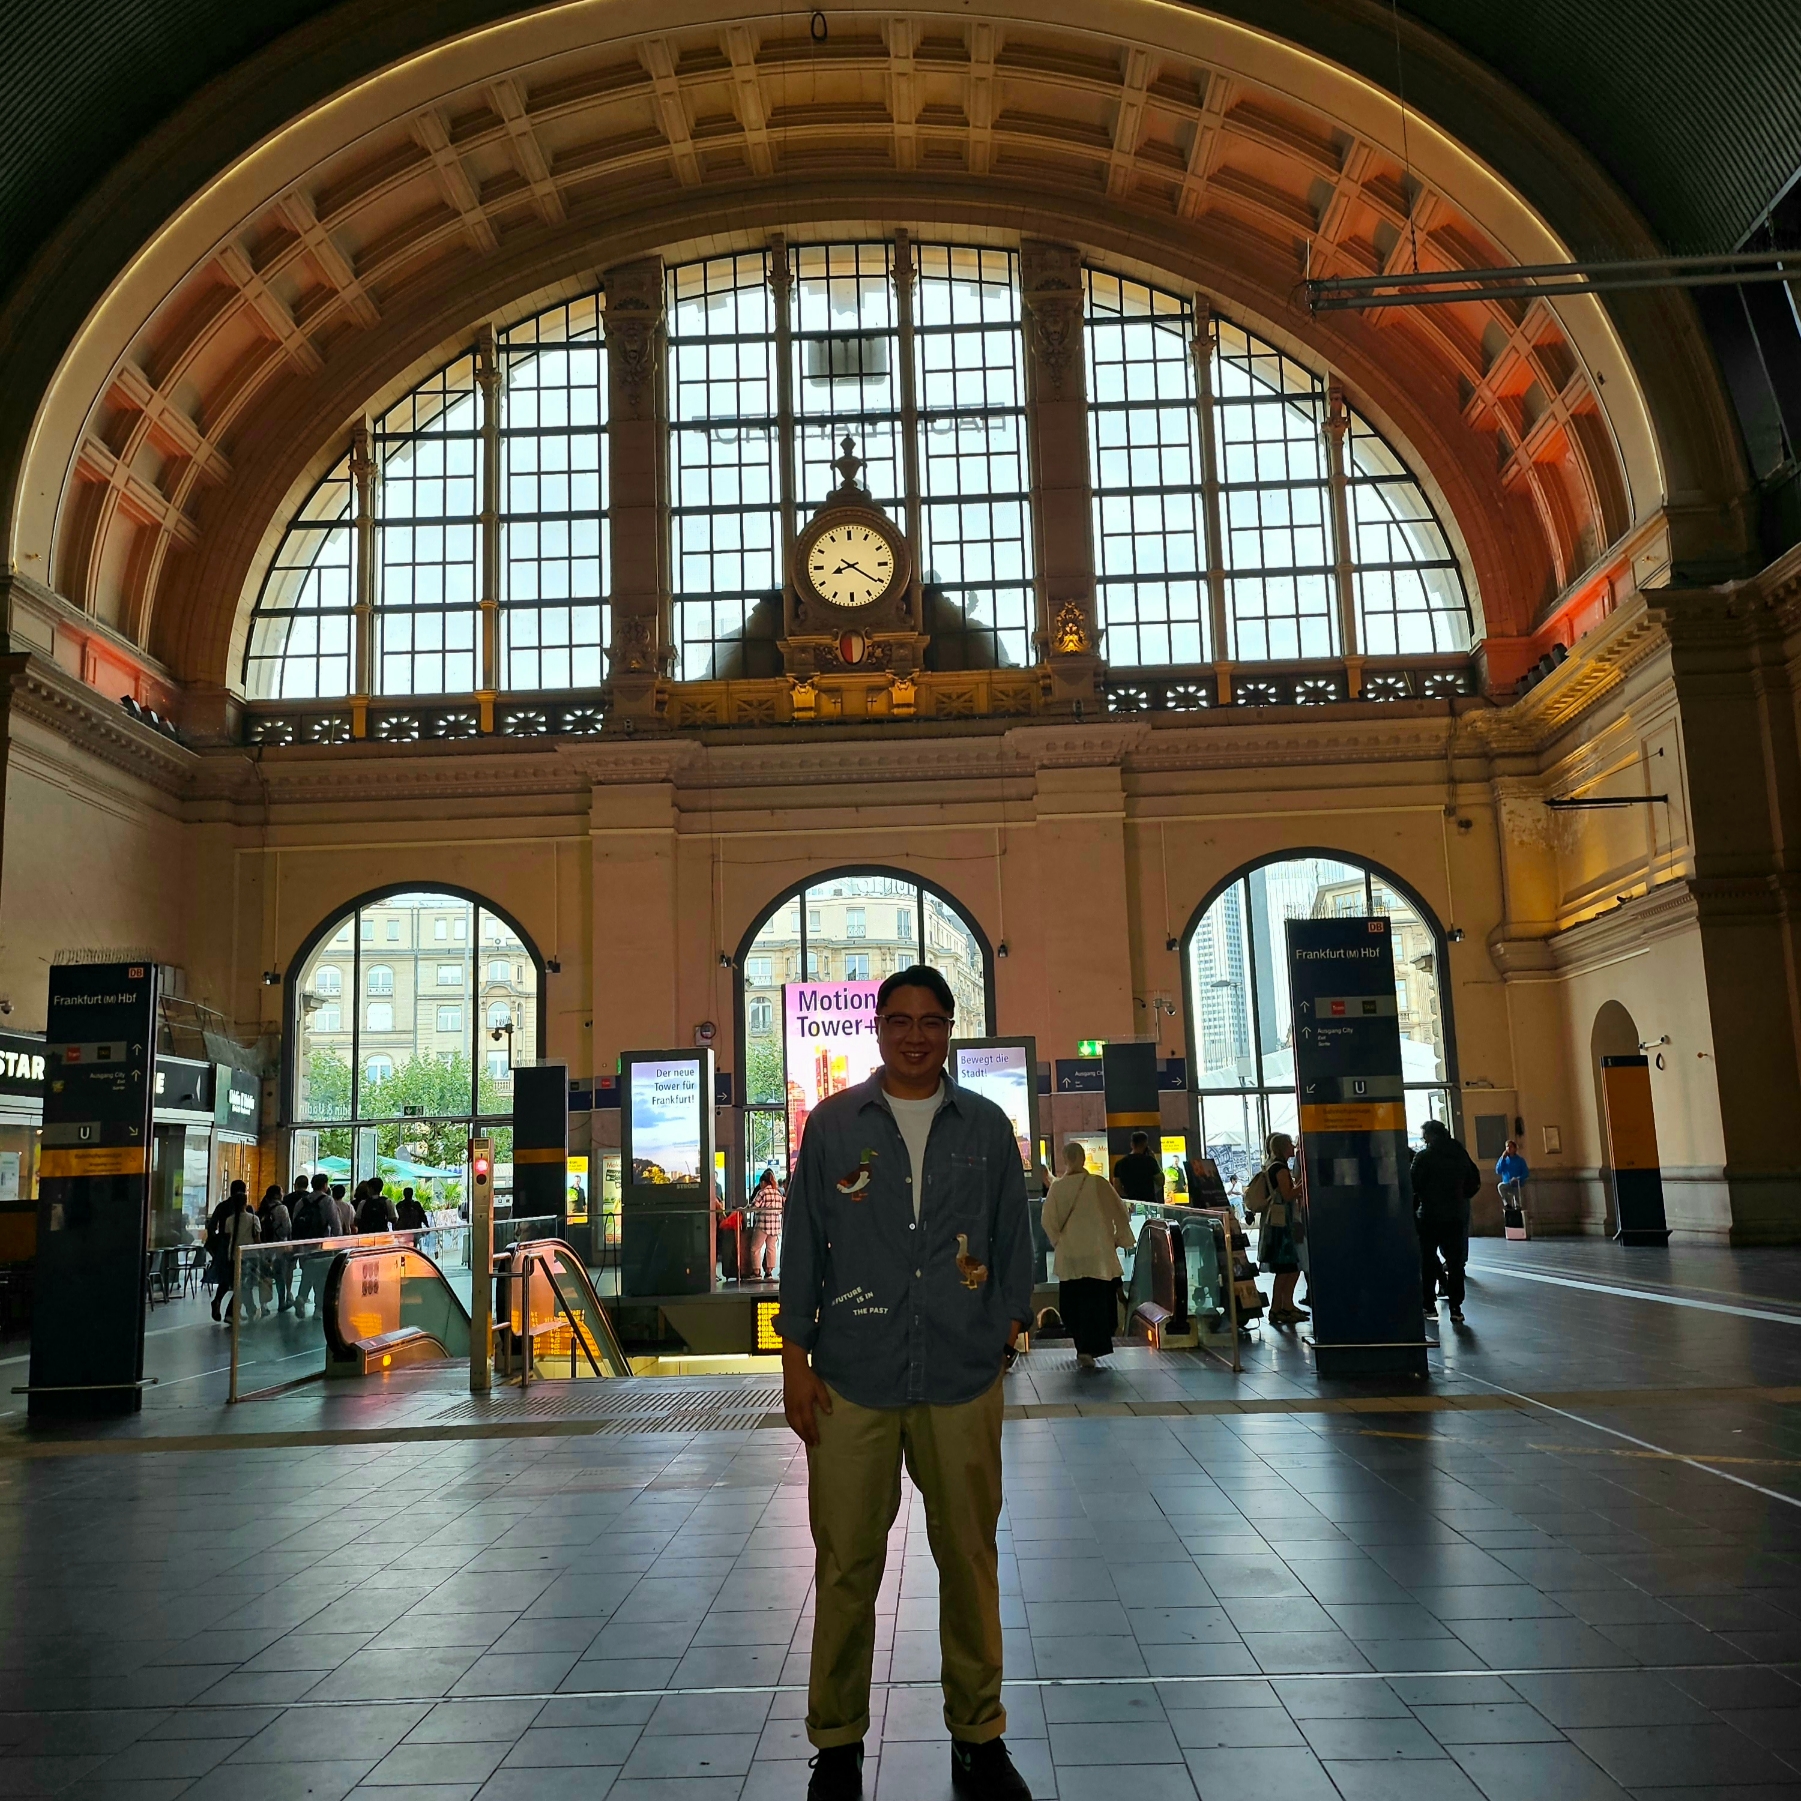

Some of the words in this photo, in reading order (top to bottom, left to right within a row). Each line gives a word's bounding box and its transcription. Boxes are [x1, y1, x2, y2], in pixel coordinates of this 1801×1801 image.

[1368, 922, 1384, 932] DB
[1295, 948, 1345, 959] Frankfurt
[1346, 949, 1359, 958] (M)
[1360, 947, 1380, 958] Hbf
[130, 968, 144, 978] DB
[53, 994, 102, 1006] Frankfurt
[104, 995, 116, 1005] (M)
[118, 992, 138, 1004] Hbf
[798, 987, 876, 1012] Motion
[796, 1016, 877, 1037] Tower+
[960, 1055, 993, 1066] Bewegt
[996, 1054, 1009, 1063] die
[656, 1069, 672, 1078] Der
[962, 1068, 988, 1078] Stadt!
[654, 1082, 680, 1091] Tower
[682, 1080, 695, 1090] für
[1354, 1081, 1365, 1094] U
[652, 1094, 695, 1105] Frankfurt!
[80, 1126, 90, 1140] U
[856, 1296, 864, 1304] IS
[864, 1292, 874, 1300] IN
[852, 1308, 868, 1316] THE
